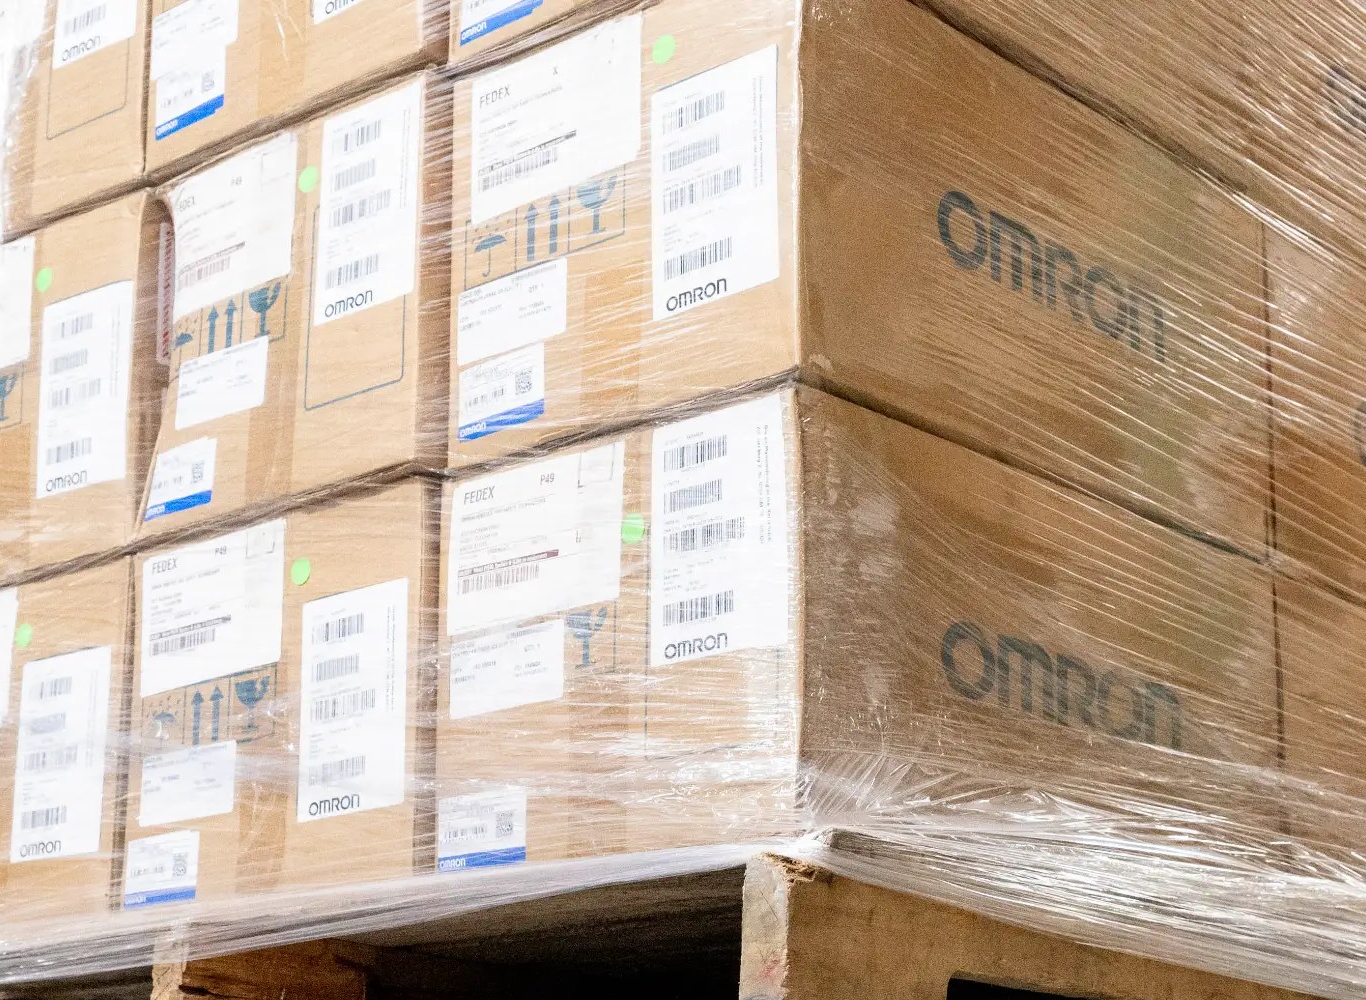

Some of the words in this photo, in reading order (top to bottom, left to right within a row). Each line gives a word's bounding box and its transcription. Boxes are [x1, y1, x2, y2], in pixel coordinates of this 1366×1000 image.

[61, 35, 101, 62] OMRON
[479, 84, 511, 109] FEDEX
[937, 190, 1166, 362] OMRON
[324, 290, 373, 318] OMRON
[666, 278, 727, 312] OMRON
[46, 470, 87, 493] OMRON
[540, 472, 555, 486] P49
[464, 486, 495, 506] FEDEX
[152, 558, 178, 575] FEDEX
[664, 632, 728, 659] OMRON
[941, 620, 1184, 750] OMRON
[309, 794, 360, 816] OMRON
[20, 840, 62, 858] OMRON
